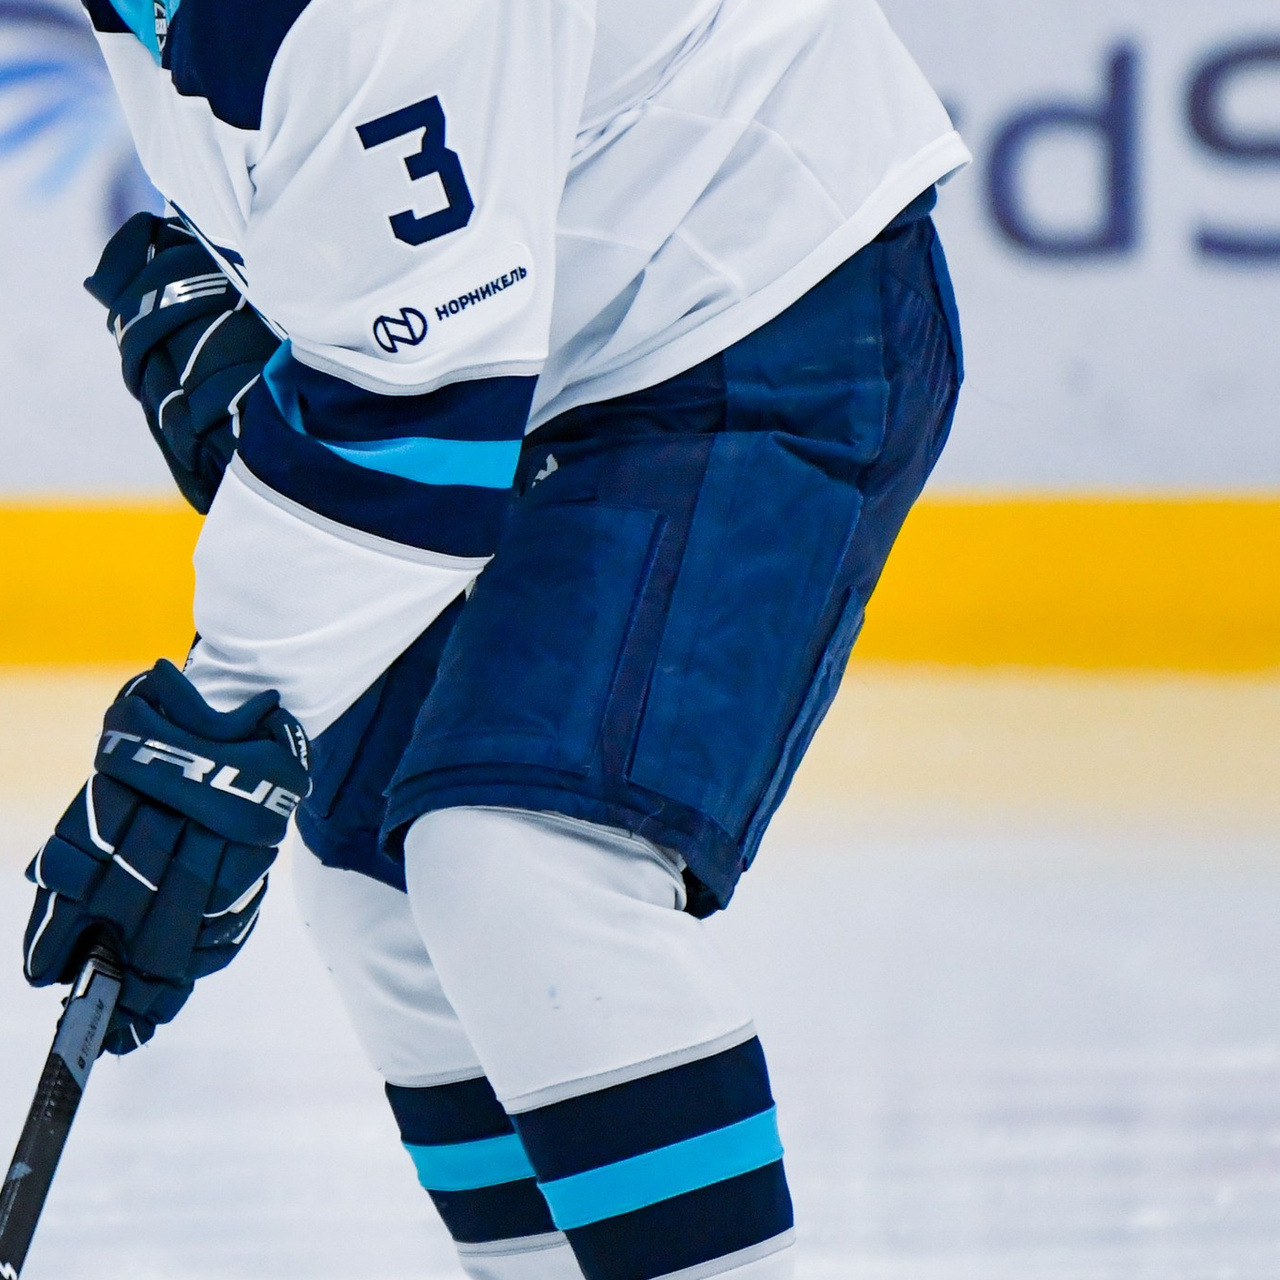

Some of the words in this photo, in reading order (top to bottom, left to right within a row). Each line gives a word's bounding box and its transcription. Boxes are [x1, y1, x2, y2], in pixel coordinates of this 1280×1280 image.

[355, 95, 475, 247] 3
[435, 266, 528, 321] НОРНИКЕЛЬ
[102, 730, 301, 818] TRUE
